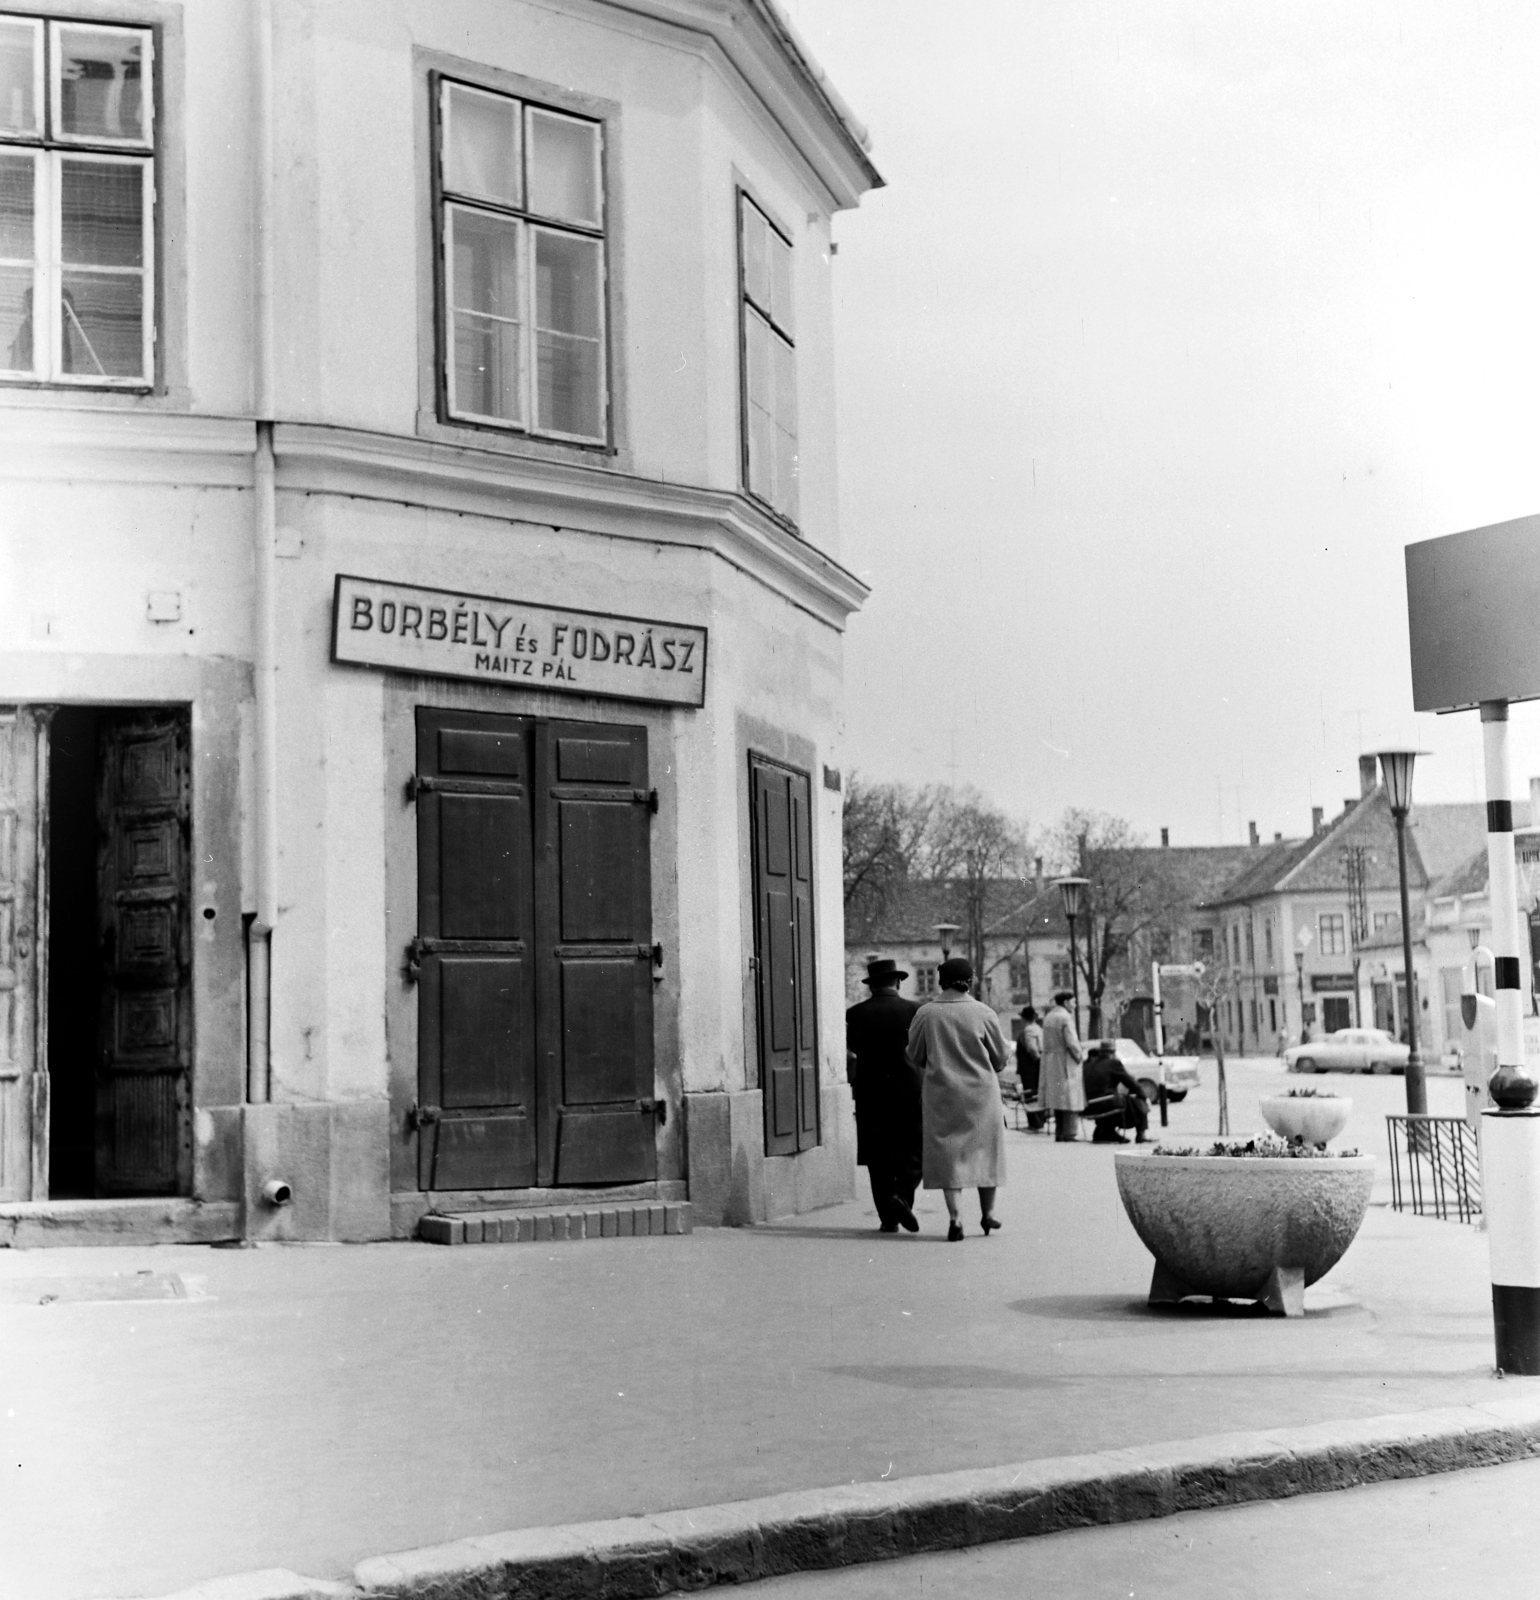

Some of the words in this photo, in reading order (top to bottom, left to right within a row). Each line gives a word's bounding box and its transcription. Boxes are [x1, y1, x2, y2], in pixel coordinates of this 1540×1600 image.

[351, 597, 513, 649] BORBÉLY
[515, 623, 538, 653] ÉS
[551, 623, 694, 673] FODRÁSZ
[475, 653, 533, 676] MAITZ
[542, 656, 577, 681] PÁL
